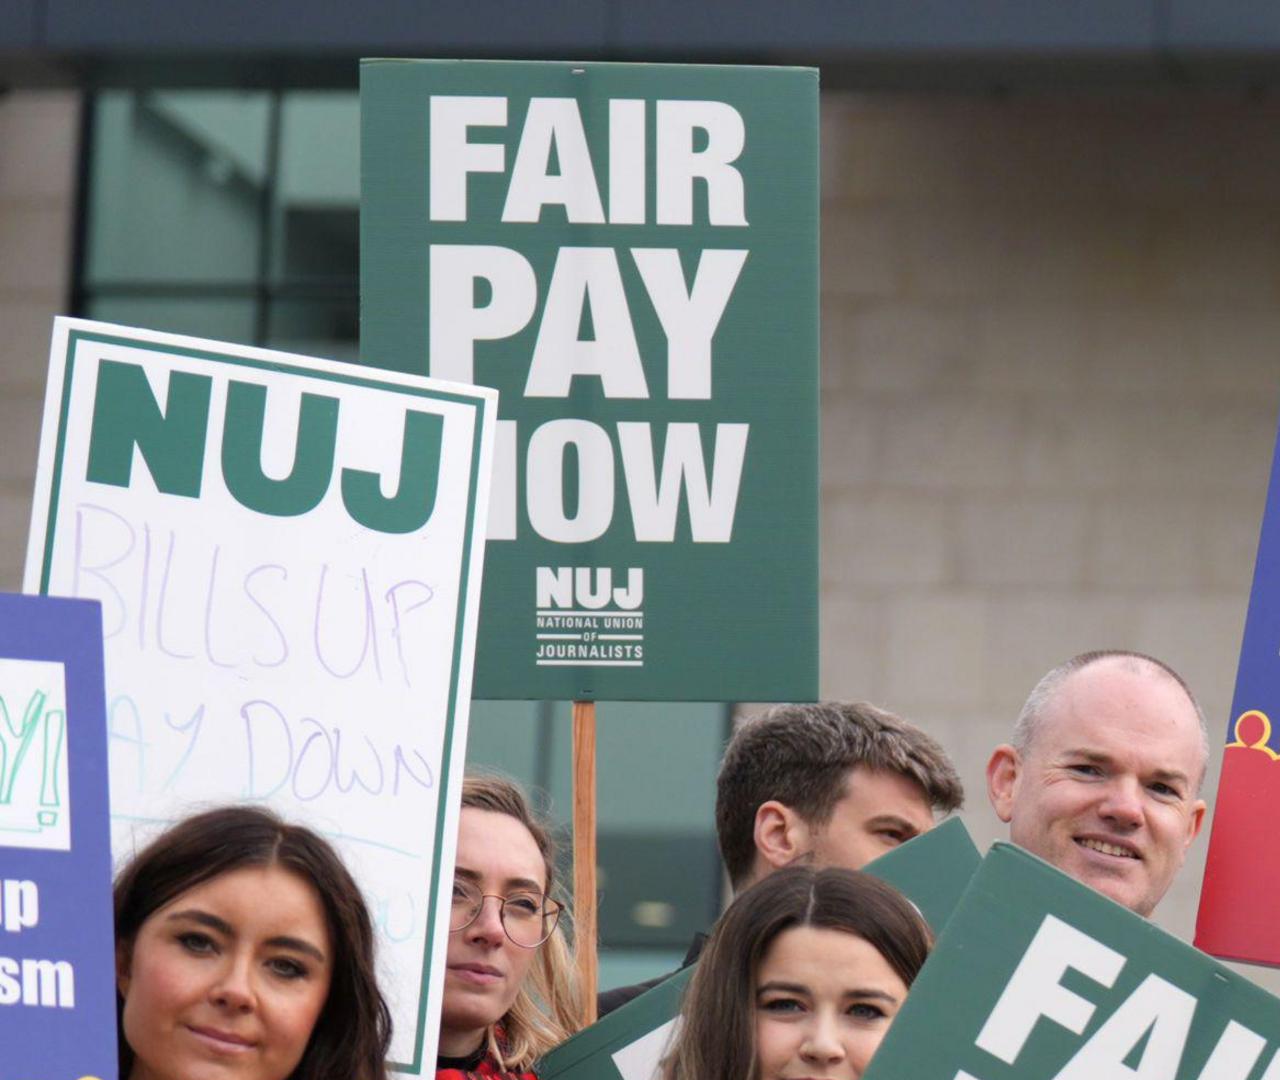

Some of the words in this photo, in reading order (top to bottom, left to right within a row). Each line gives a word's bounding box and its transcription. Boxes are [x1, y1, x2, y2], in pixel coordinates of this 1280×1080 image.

[429, 95, 749, 226] FAIR
[429, 245, 749, 399] PAY
[86, 358, 445, 534] NUJ
[73, 503, 288, 669] BILLS
[315, 563, 434, 688] UP
[536, 567, 644, 610] NUJ
[536, 617, 599, 628] NATIONAL
[604, 618, 643, 629] UNION
[536, 644, 643, 658] JOURNALISTS
[583, 632, 597, 642] OF
[110, 695, 205, 793] AY
[240, 699, 434, 801] DOWN
[0, 879, 39, 932] p
